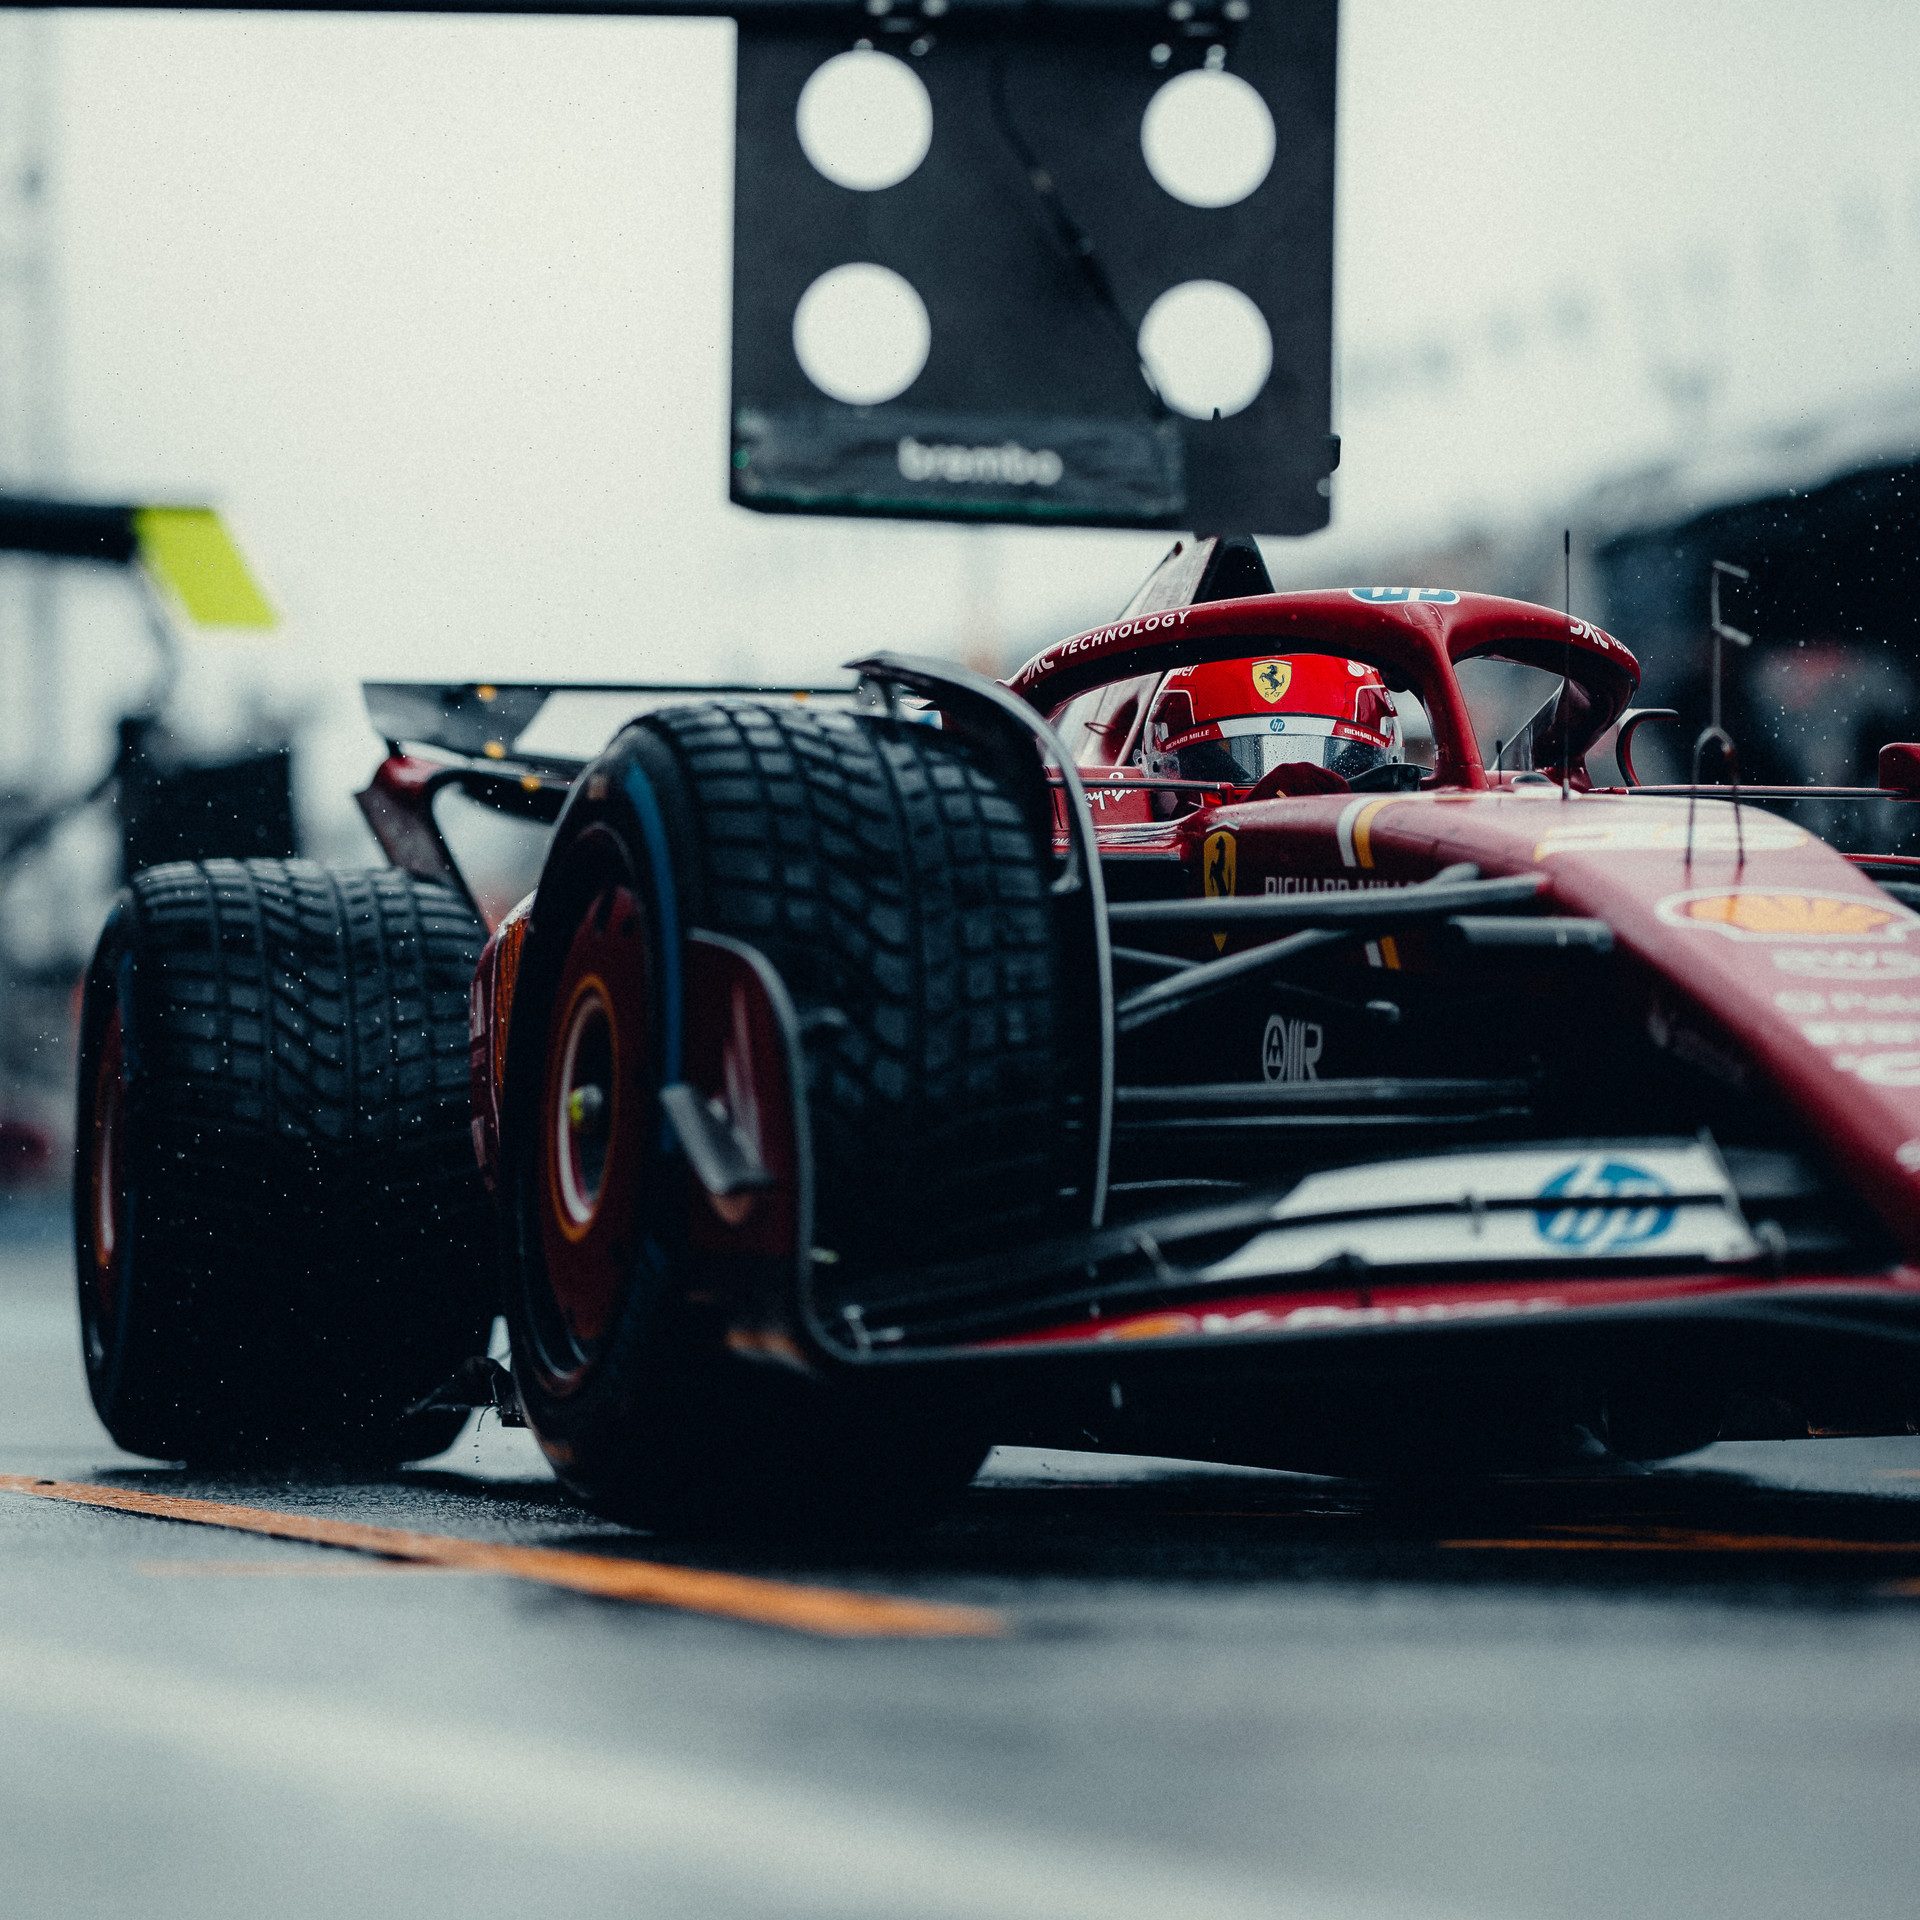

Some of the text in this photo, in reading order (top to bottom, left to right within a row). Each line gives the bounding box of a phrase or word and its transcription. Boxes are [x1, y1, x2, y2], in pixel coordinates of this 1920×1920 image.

[1061, 610, 1191, 657] TECHNOLOGY
[1271, 718, 1284, 732] hp
[1344, 727, 1372, 741] RICHARD
[1165, 729, 1210, 751] RICHARD MILLE
